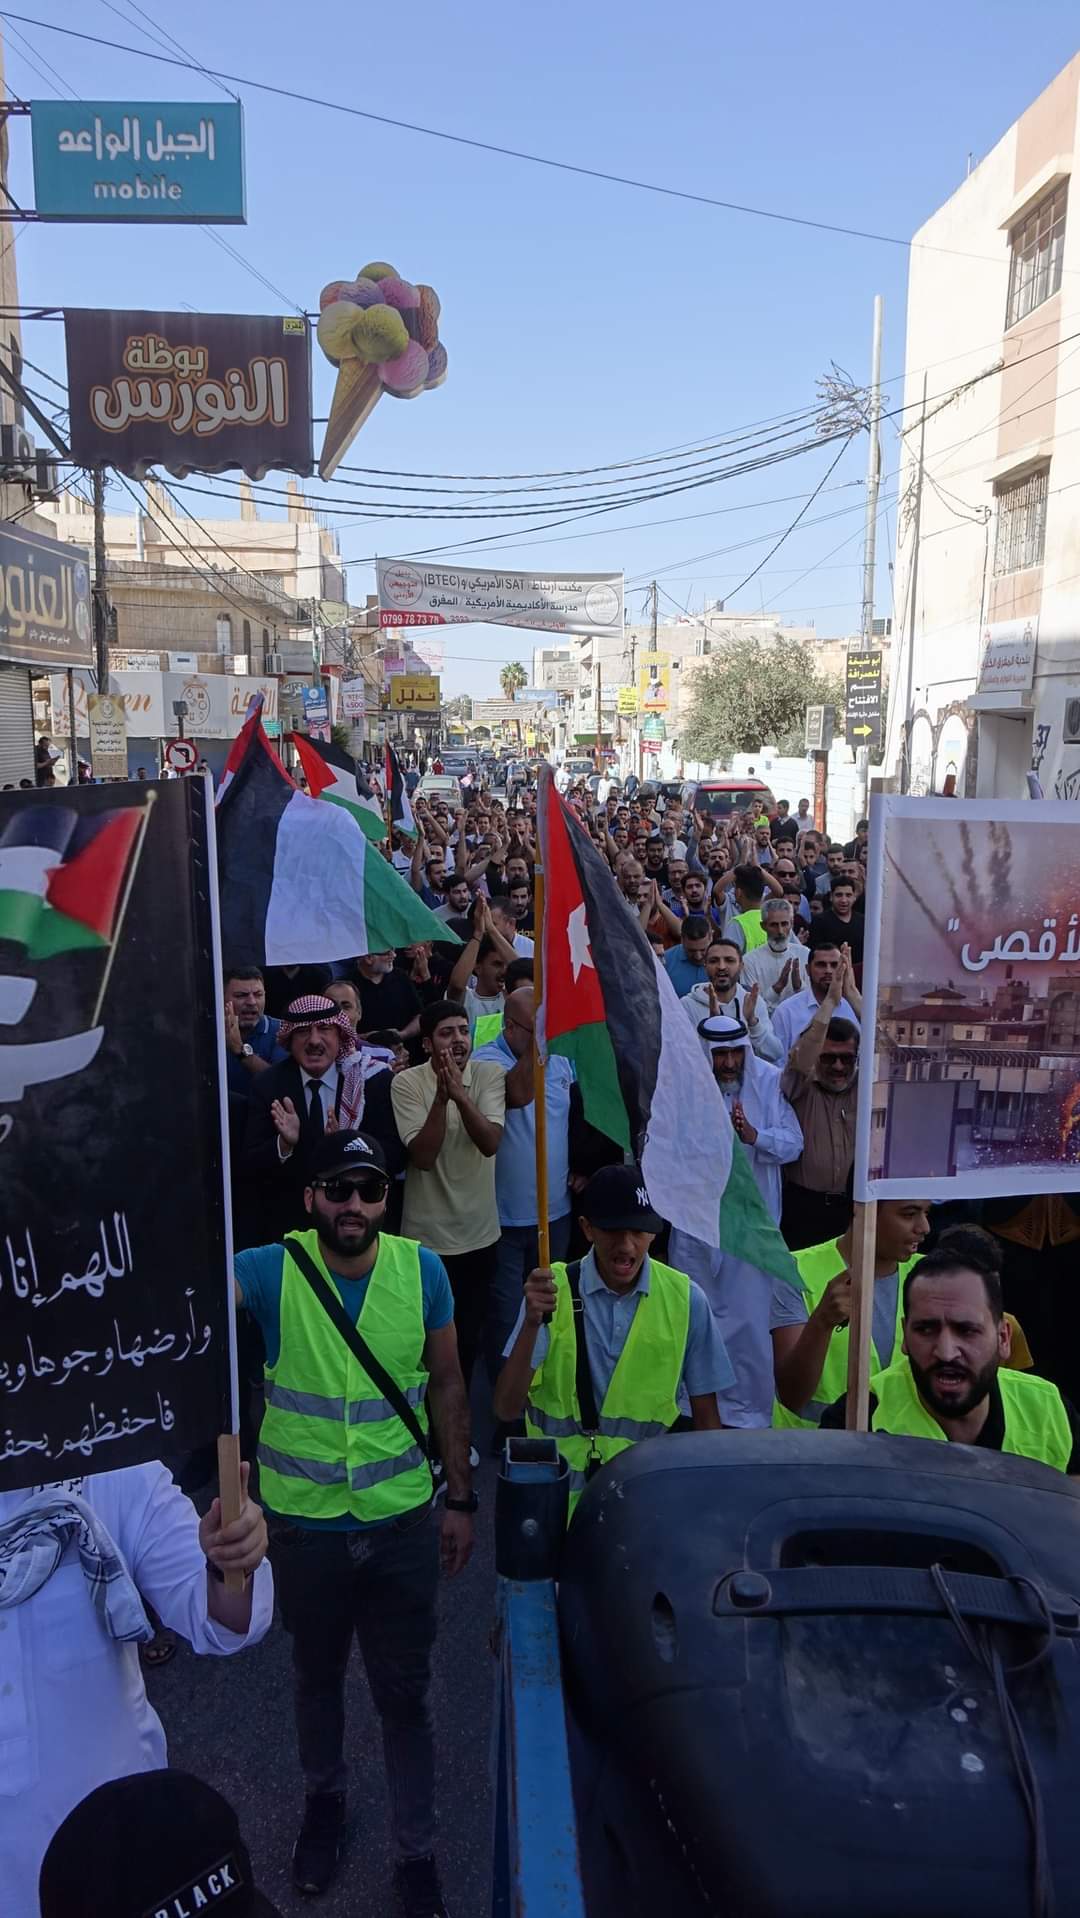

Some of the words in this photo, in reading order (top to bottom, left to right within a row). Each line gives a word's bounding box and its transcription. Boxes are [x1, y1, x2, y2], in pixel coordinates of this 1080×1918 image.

[58, 118, 141, 161] الواعد
[146, 119, 215, 161] الجيل
[93, 175, 183, 200] mobile
[125, 335, 206, 378] بوظة
[94, 360, 286, 433] النورس
[468, 575, 504, 592] الأمريكي
[506, 578, 524, 591] SAT
[0, 554, 73, 638] العنو
[429, 594, 458, 608] المفرق
[466, 595, 505, 610] الأمريكية
[506, 596, 549, 612] الأكاديمية
[550, 601, 578, 613] مدرسة
[382, 614, 402, 625] 0799
[404, 615, 415, 625] 78
[417, 615, 427, 625] 73
[847, 668, 880, 680] للصرافة
[848, 694, 879, 709] الافتتاح
[635, 1186, 649, 1207] NY
[47, 1210, 133, 1304] اللهم
[55, 1391, 175, 1460] فاحفظهم
